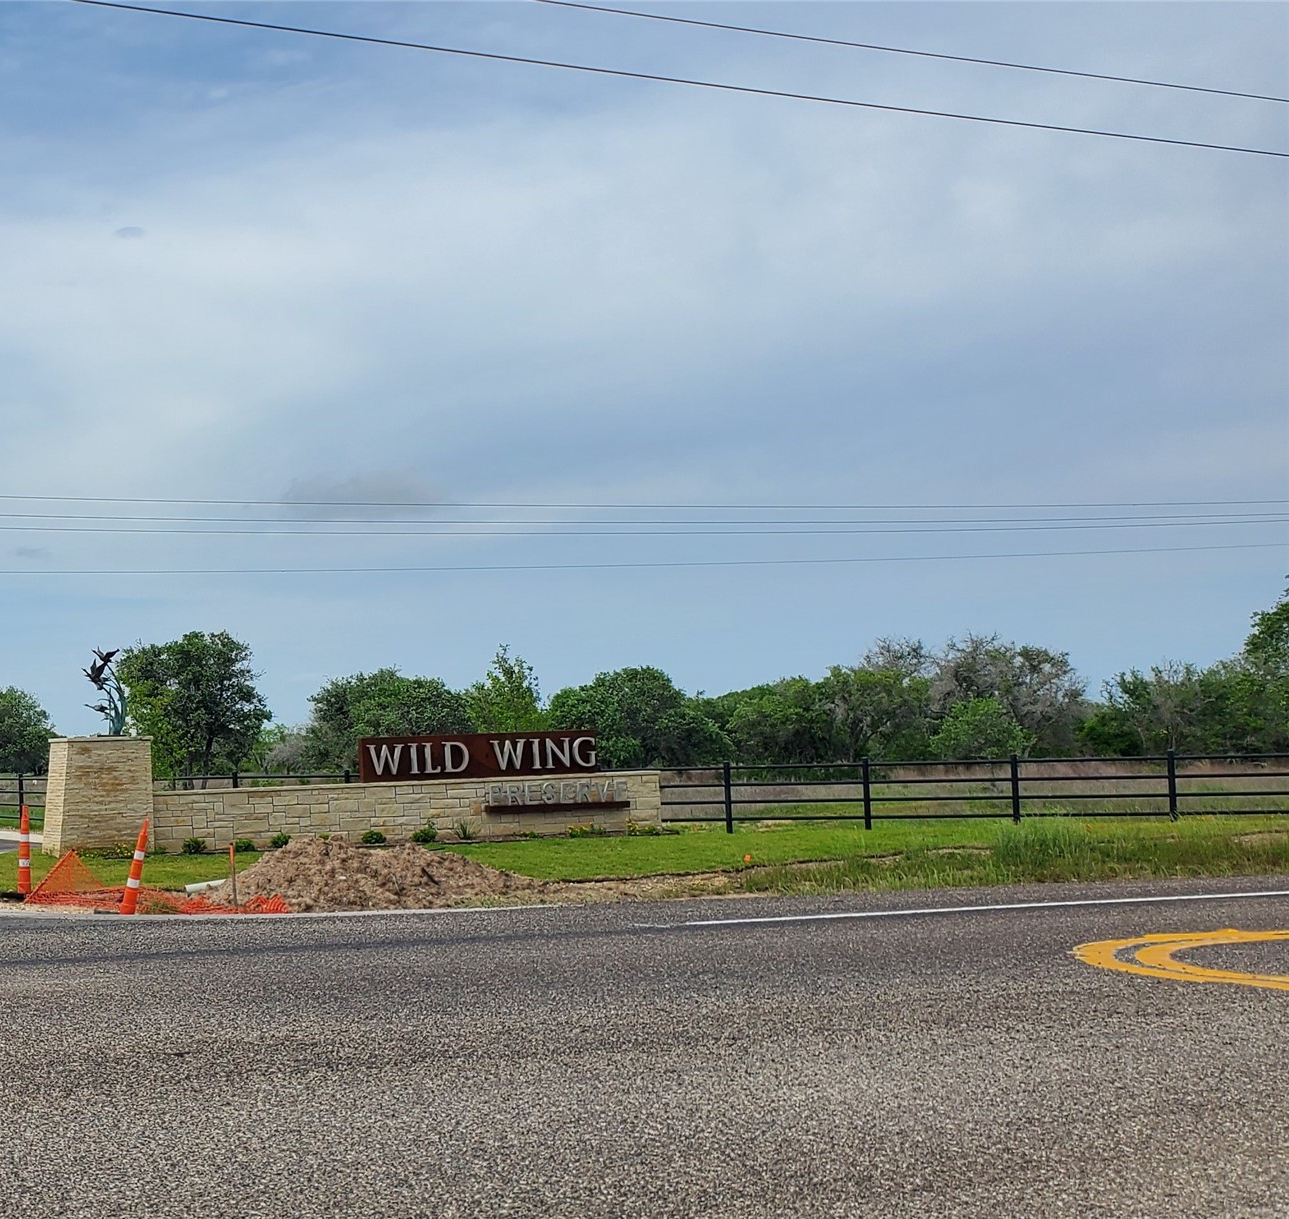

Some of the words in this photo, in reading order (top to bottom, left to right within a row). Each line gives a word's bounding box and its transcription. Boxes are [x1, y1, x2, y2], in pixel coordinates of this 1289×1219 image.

[367, 742, 470, 775] WILD
[491, 737, 597, 771] WING
[489, 780, 628, 805] PRESERVE
